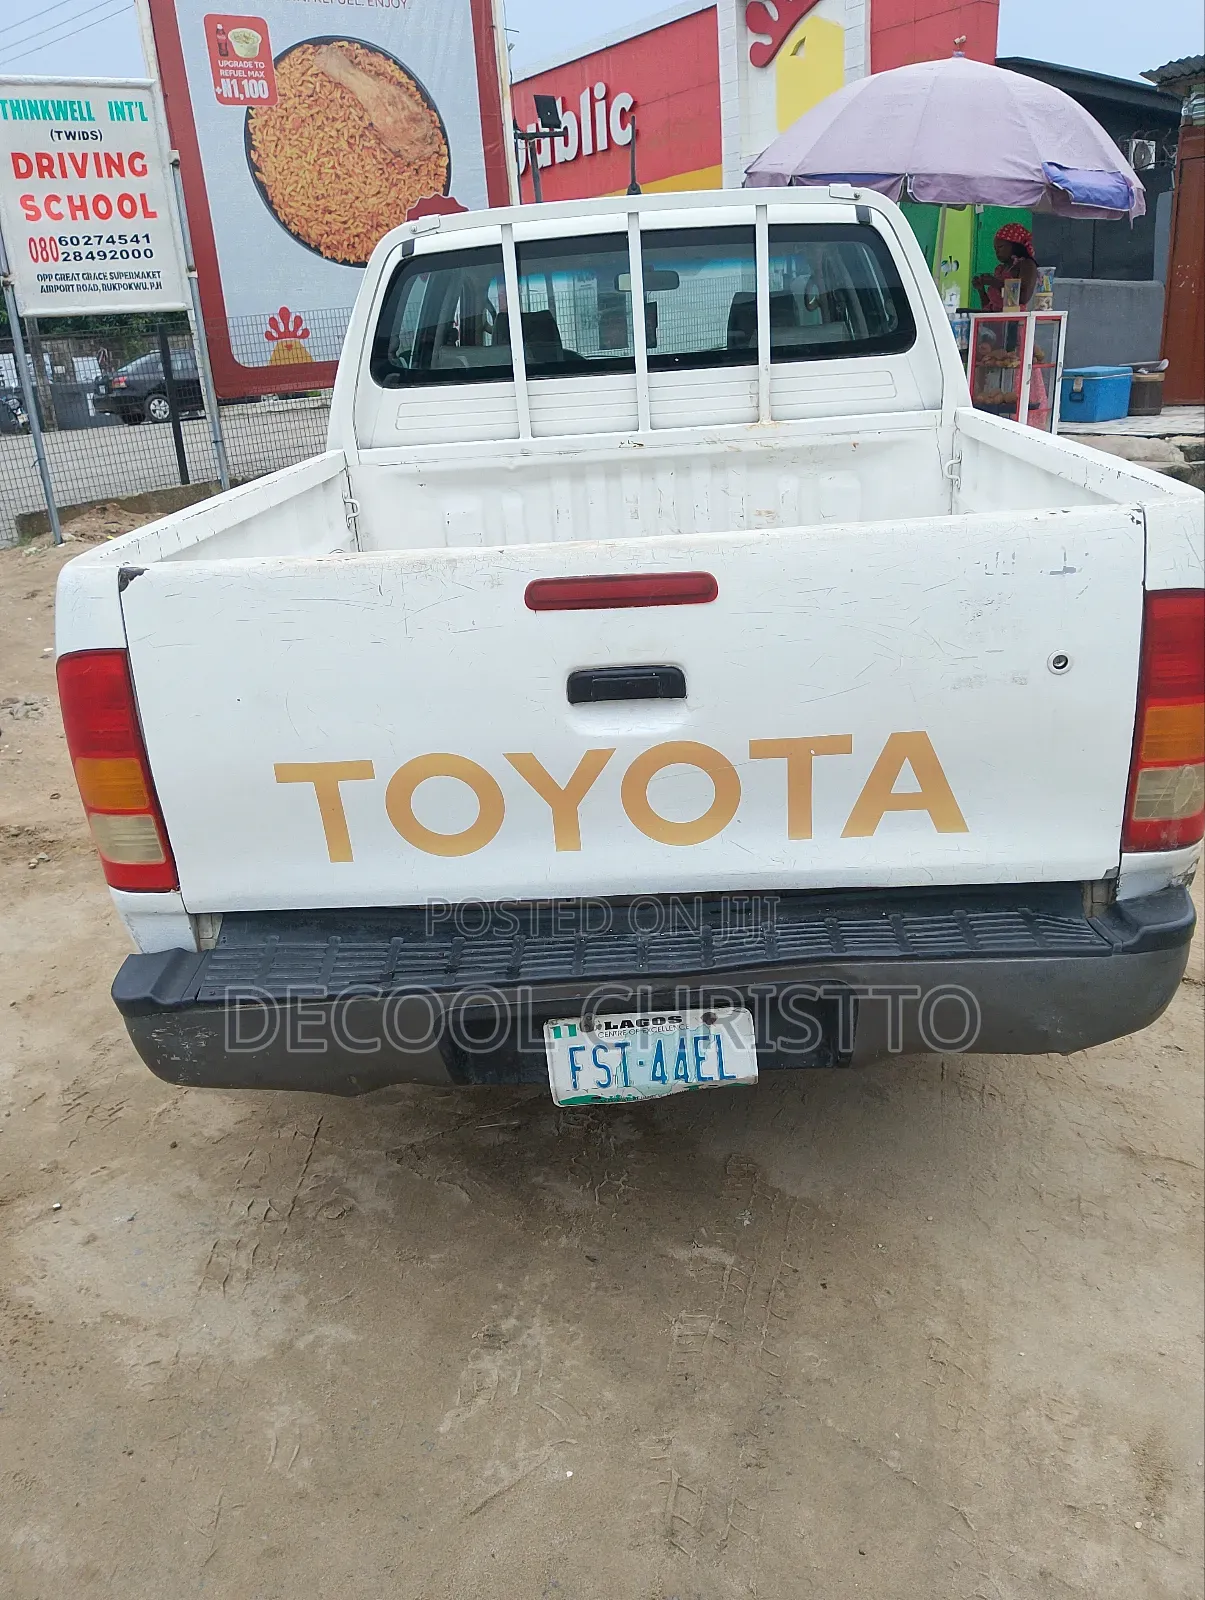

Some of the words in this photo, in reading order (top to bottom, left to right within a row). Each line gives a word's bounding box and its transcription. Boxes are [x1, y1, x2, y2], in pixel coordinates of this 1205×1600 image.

[218, 60, 253, 68] UPGRADE
[254, 61, 265, 69] TO
[220, 69, 247, 78] REFUEL
[247, 70, 265, 78] MAX
[0, 99, 96, 122] THINKWELL
[108, 100, 149, 122] INT'L
[50, 128, 103, 142] (TWIDS)
[11, 151, 148, 179] DRIVING
[19, 192, 158, 222] SCHOOL
[28, 236, 60, 263] 080
[58, 233, 151, 247] 60274541
[61, 248, 154, 262] 28492000
[36, 273, 53, 282] OPP
[54, 272, 80, 282] GREAT
[81, 271, 108, 281] GRACE
[40, 284, 75, 293] AIRPORT
[76, 283, 101, 293] ROAD,
[273, 730, 970, 863] TOYOTA
[597, 1030, 627, 1039] CENTRE
[628, 1028, 639, 1036] OF
[641, 1023, 690, 1036] EXCELLENCE
[604, 1015, 683, 1031] LAGOS
